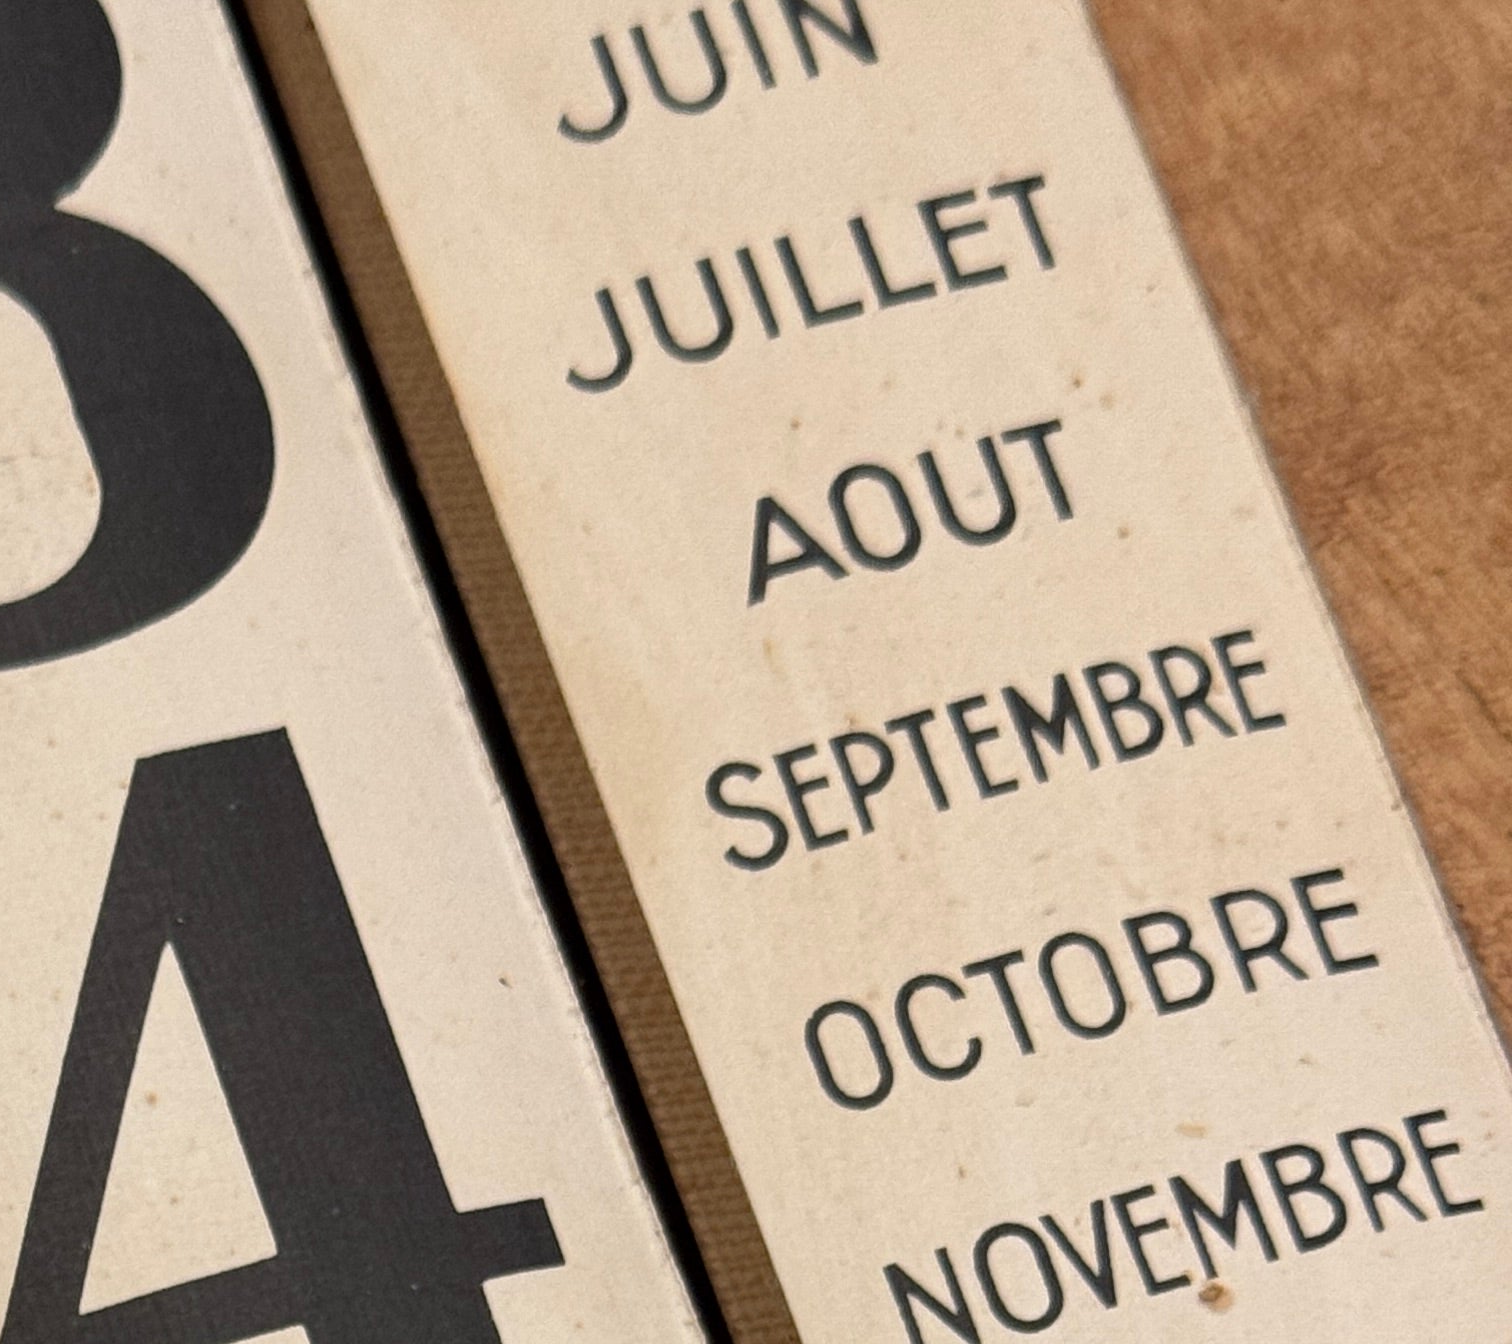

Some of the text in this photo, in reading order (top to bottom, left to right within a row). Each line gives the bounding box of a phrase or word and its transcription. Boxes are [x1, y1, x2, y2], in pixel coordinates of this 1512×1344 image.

[559, 0, 878, 142] JUIN
[567, 174, 1057, 393] JUILLET
[748, 418, 1074, 605] AOUT
[704, 629, 1287, 871] SEPTEMBRE
[804, 866, 1380, 1111] OCTOBRE
